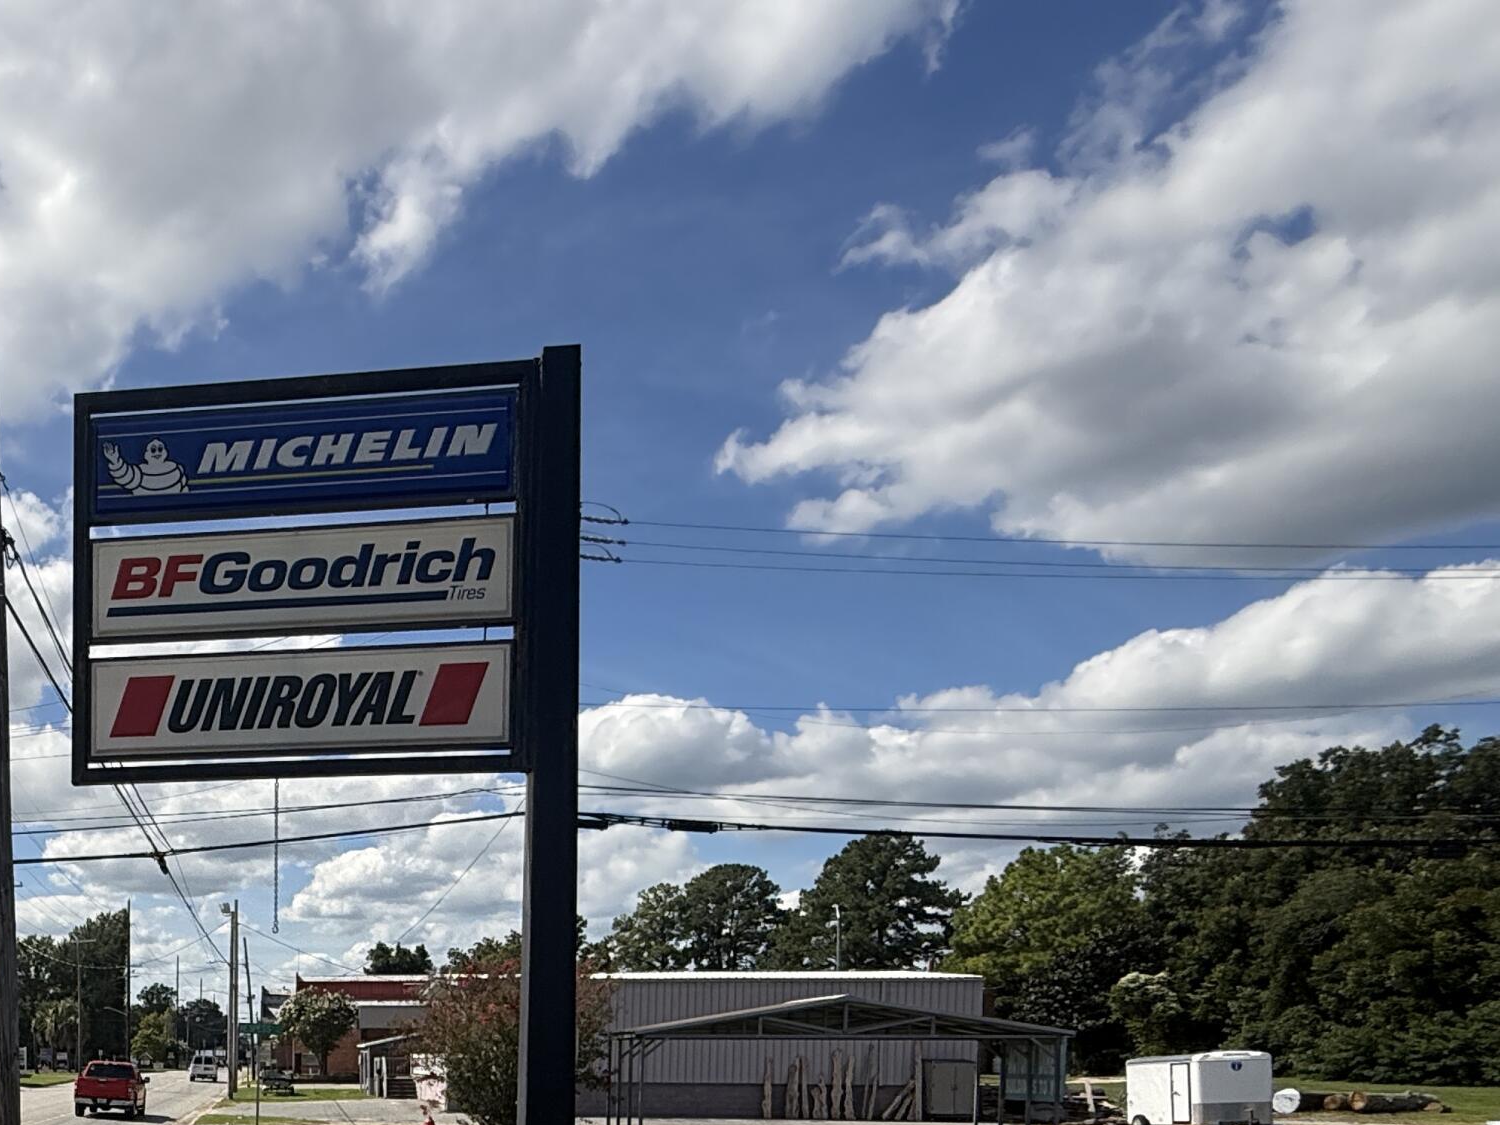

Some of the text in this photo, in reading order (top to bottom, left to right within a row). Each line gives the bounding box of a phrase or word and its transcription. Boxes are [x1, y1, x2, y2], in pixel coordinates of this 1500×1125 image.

[197, 422, 498, 475] MICHELIN
[110, 537, 496, 600] BFGoodrich
[449, 584, 487, 600] Tires
[167, 669, 421, 733] UNIROYAL
